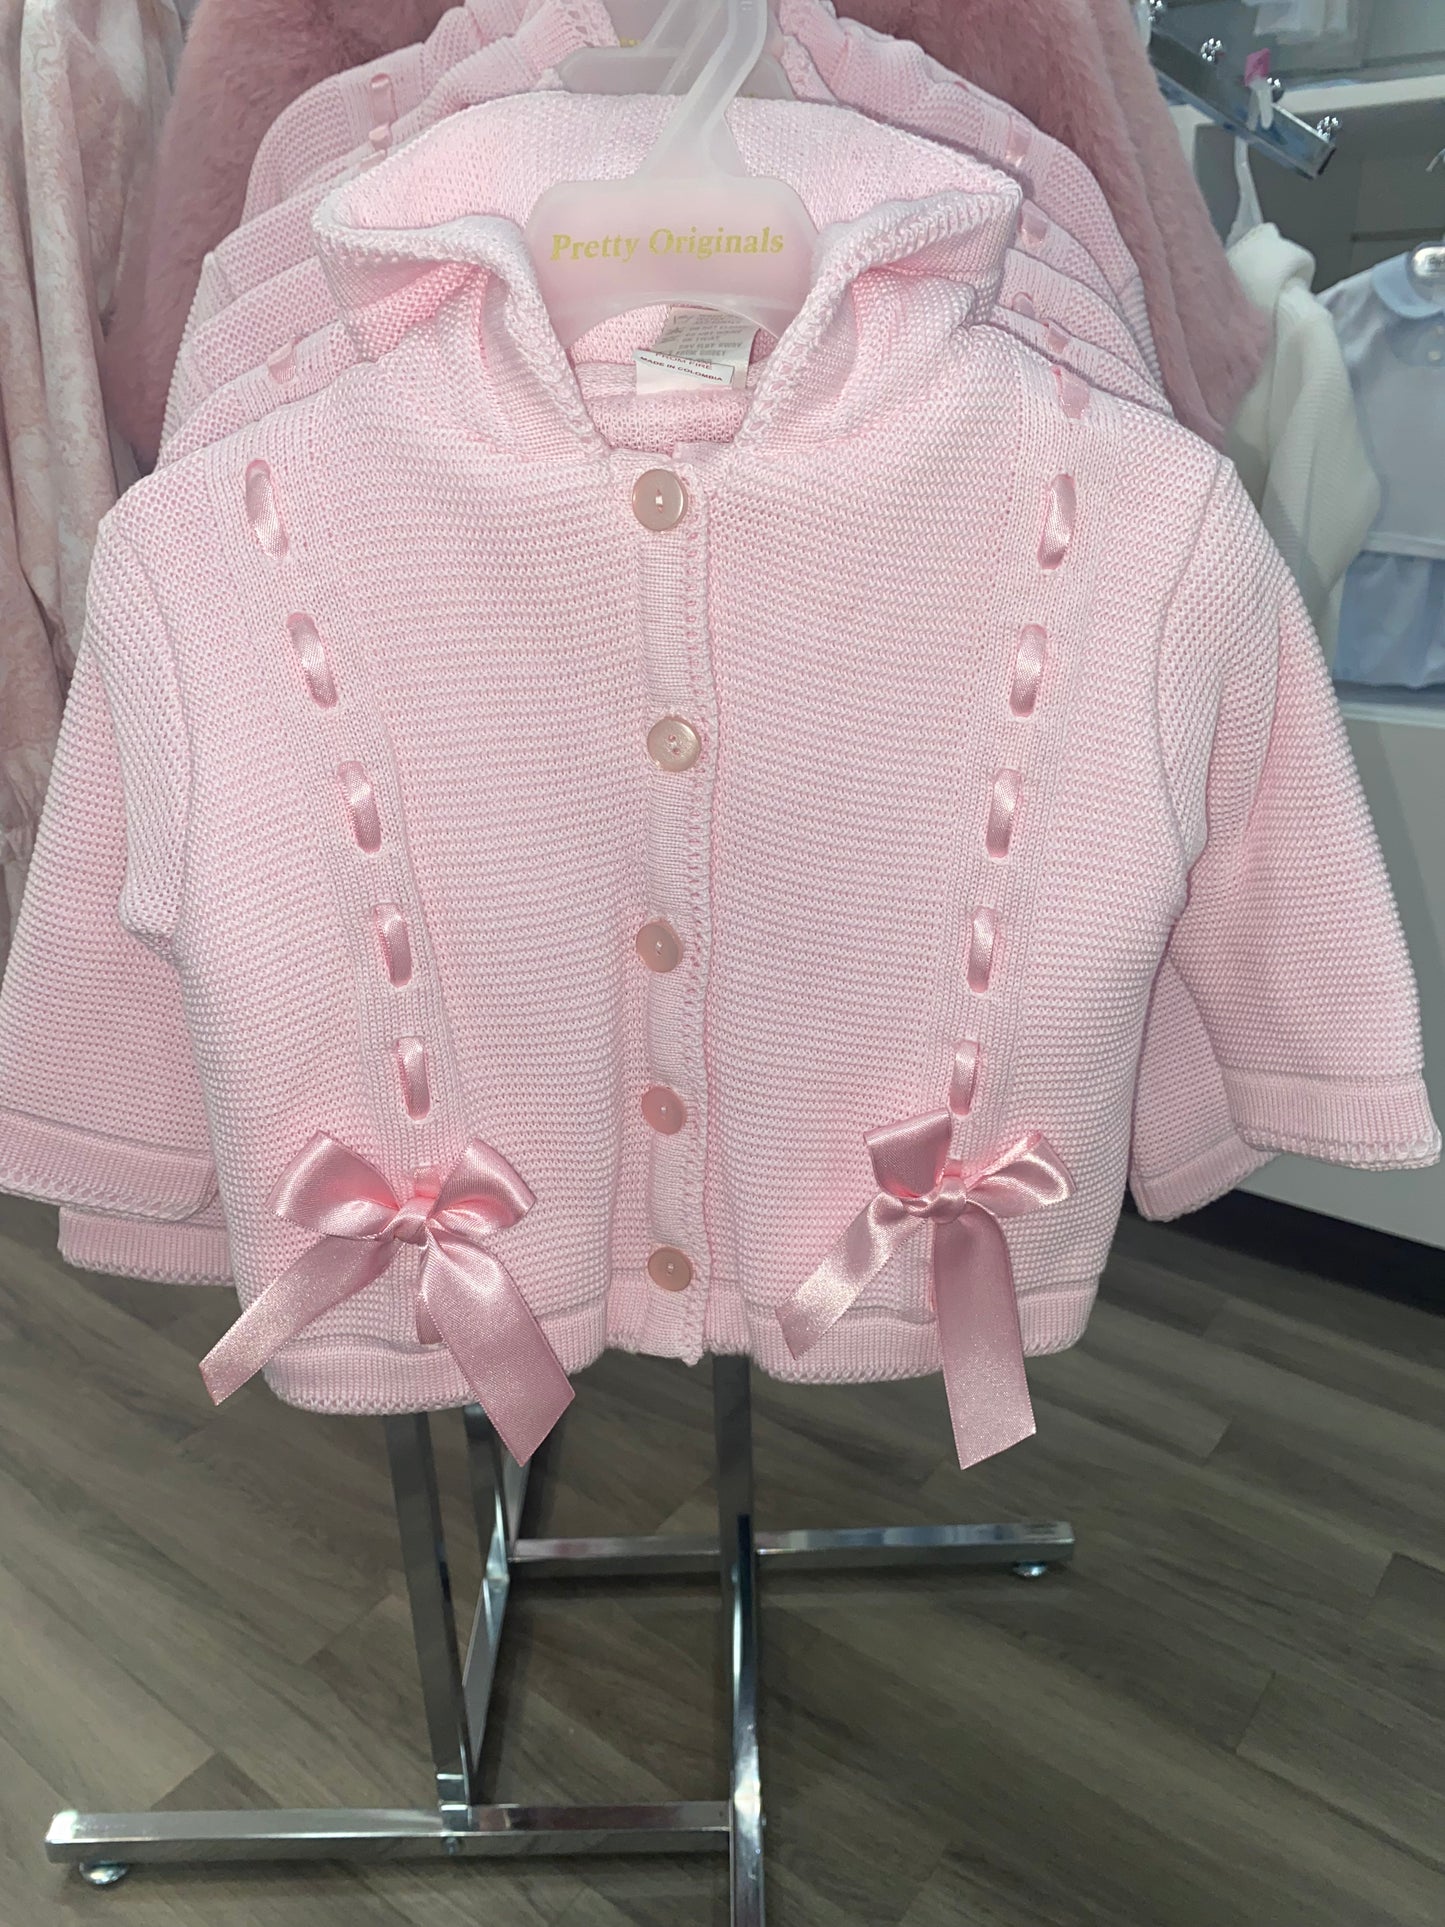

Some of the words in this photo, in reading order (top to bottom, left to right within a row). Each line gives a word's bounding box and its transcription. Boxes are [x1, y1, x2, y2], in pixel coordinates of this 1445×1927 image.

[550, 234, 640, 263] Pretty
[649, 226, 784, 260] Originals
[640, 356, 664, 366] MADE
[677, 366, 723, 381] COLOMBIA
